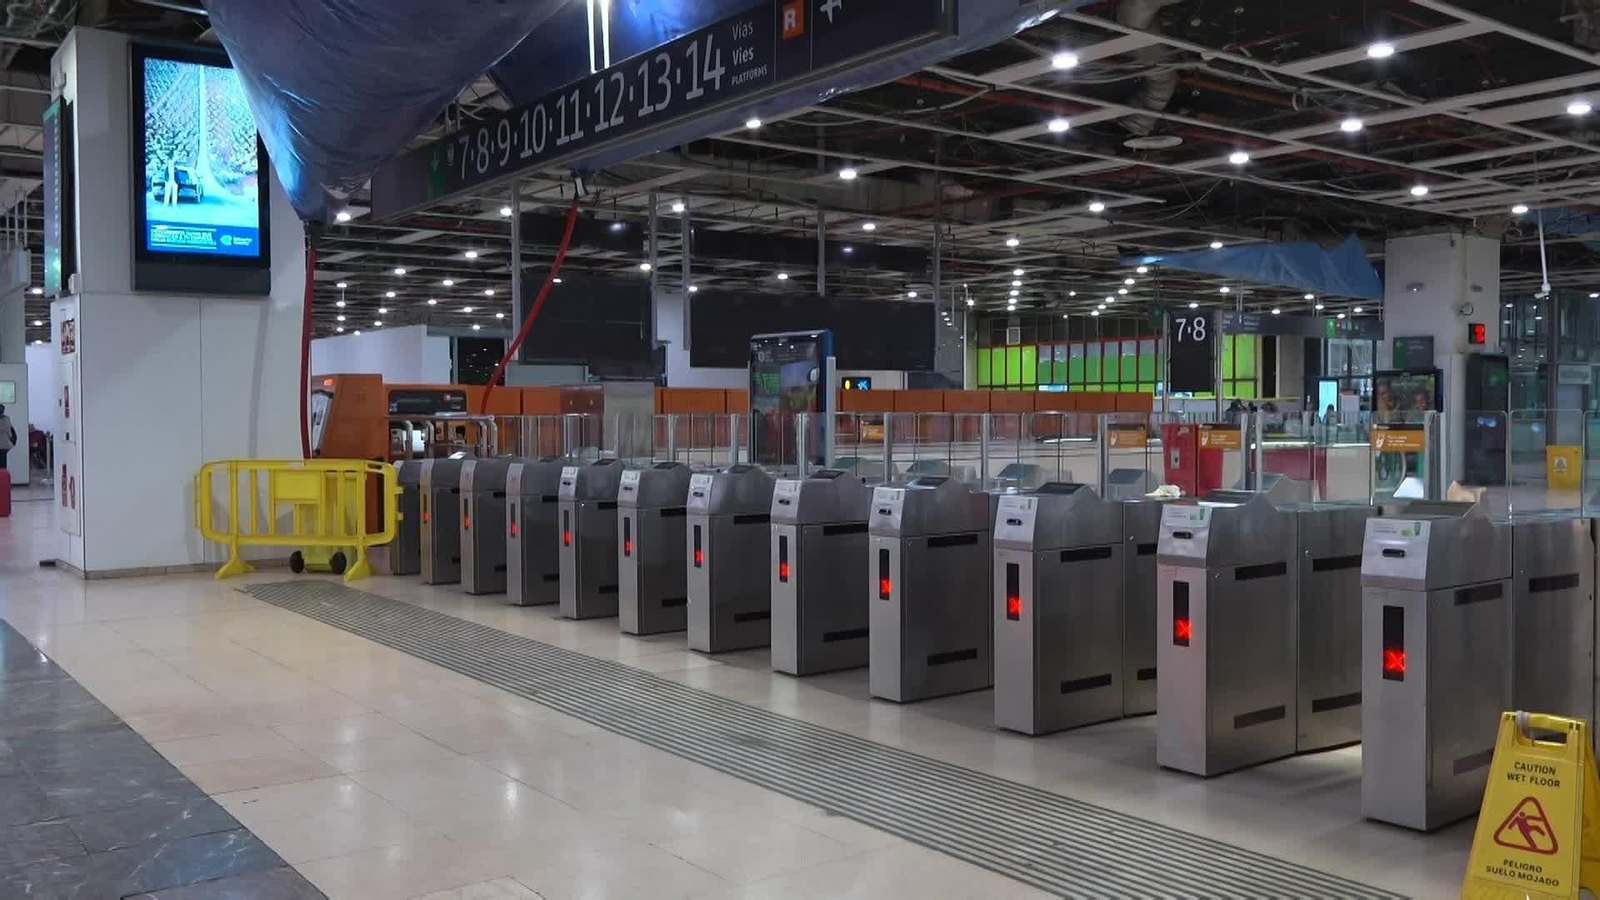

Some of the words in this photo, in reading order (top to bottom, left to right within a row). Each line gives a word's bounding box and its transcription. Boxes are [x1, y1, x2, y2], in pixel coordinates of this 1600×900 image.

[784, 8, 797, 30] R
[732, 46, 754, 66] Vies
[731, 64, 768, 86] PLATFORMS
[1514, 761, 1556, 775] CAUTION
[1507, 772, 1527, 782] WET
[1529, 776, 1560, 788] FLOOR
[1486, 865, 1516, 878] SUELO
[1517, 870, 1560, 887] MOJADO
[1503, 859, 1543, 873] PELIGRO
